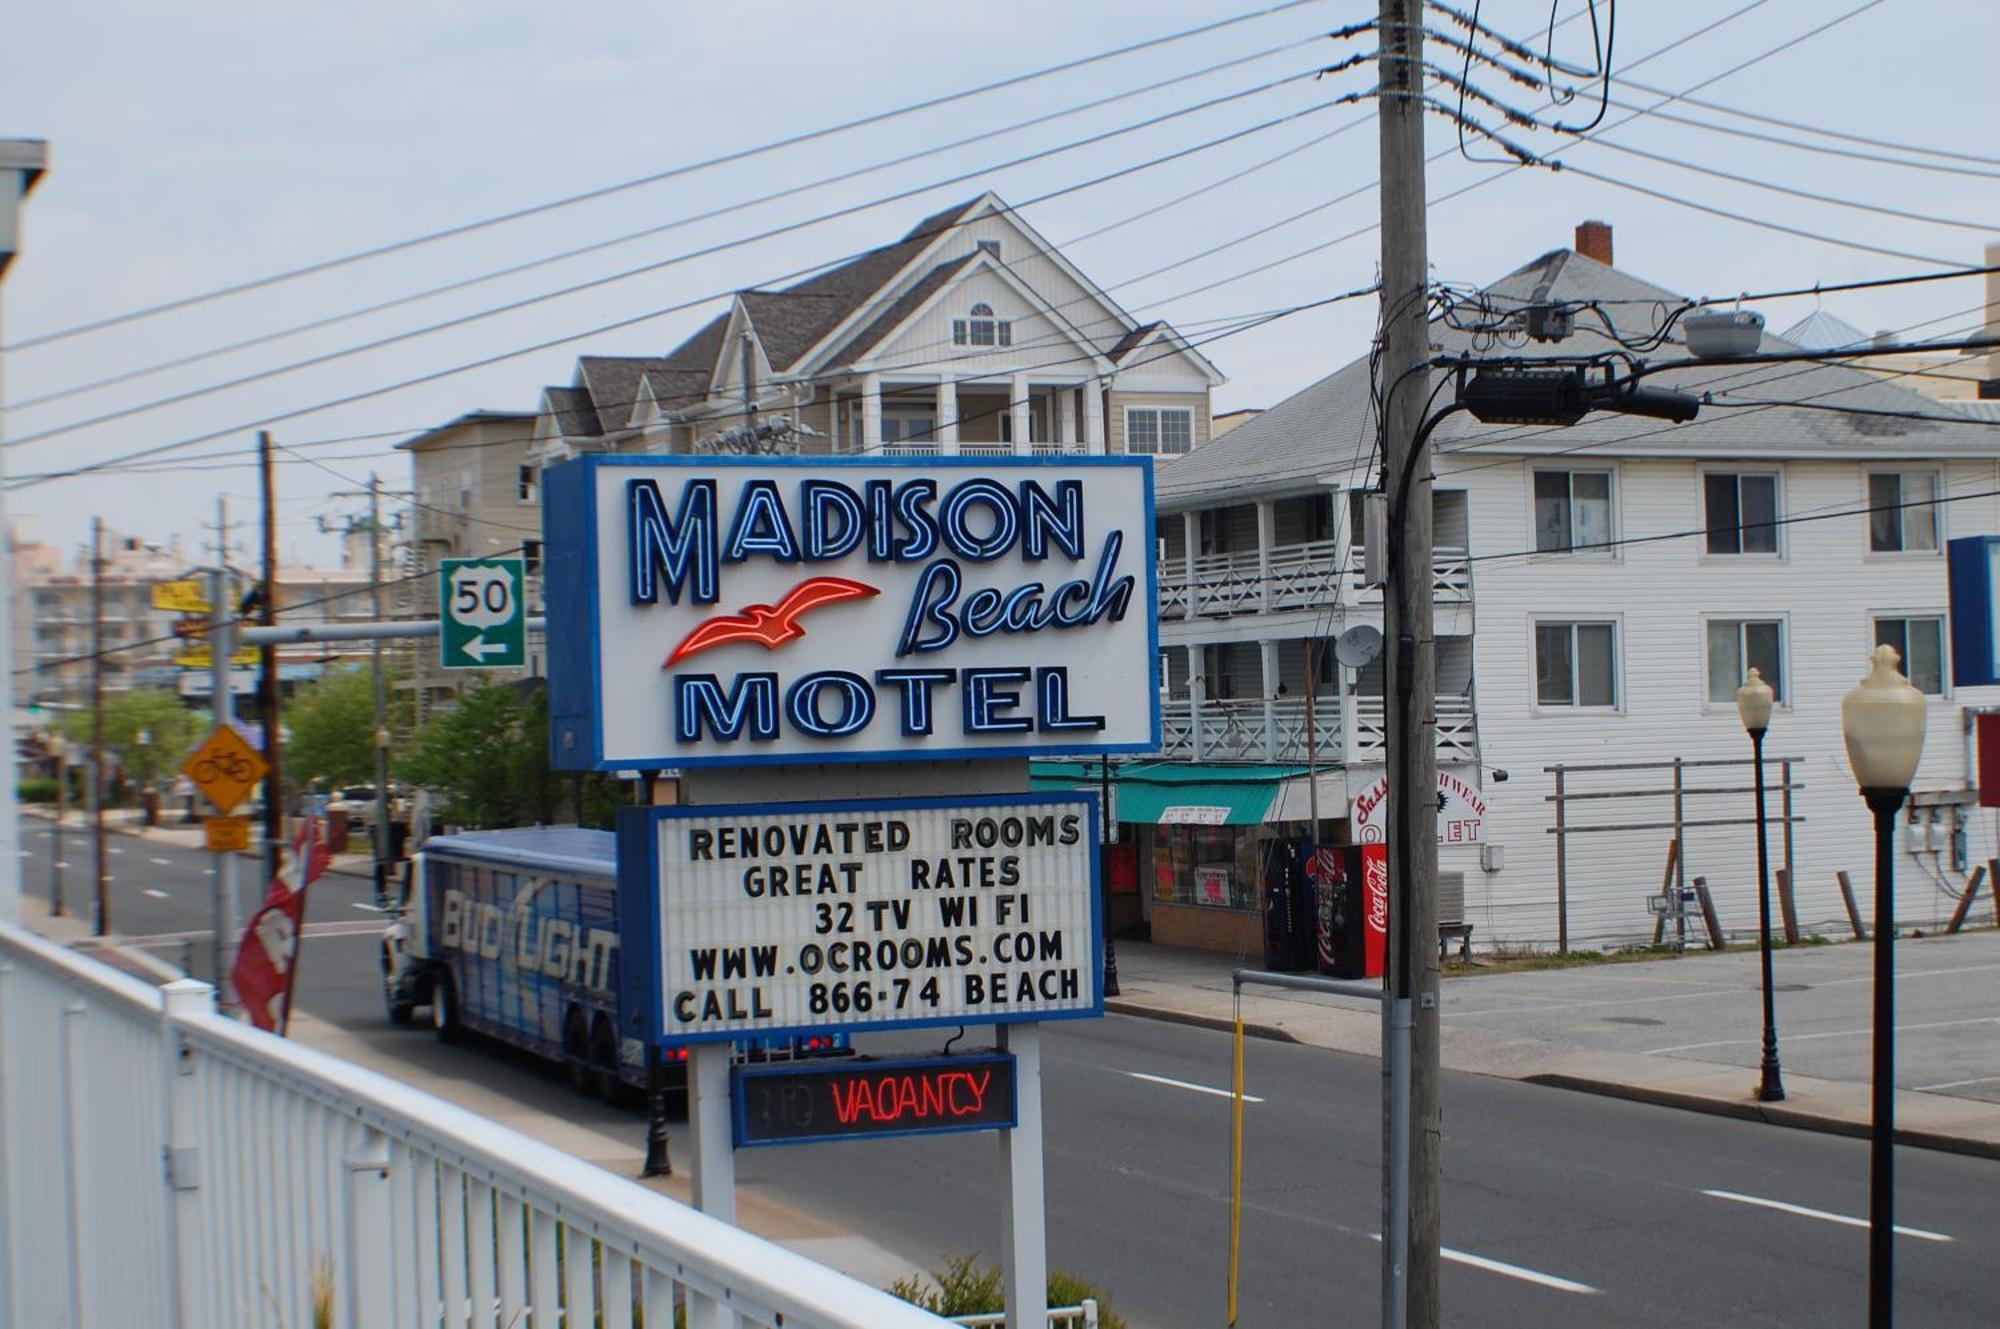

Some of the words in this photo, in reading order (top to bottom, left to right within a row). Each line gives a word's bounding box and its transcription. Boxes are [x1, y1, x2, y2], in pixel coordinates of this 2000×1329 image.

[626, 478, 1084, 606] MADISON
[457, 580, 507, 613] 50
[895, 530, 1135, 657] Beach
[674, 667, 1106, 743] MOTEL
[690, 821, 911, 860] RENOVATED
[951, 815, 1080, 849] ROOMS
[744, 862, 864, 897] GREAT
[911, 856, 1021, 889] RATES
[441, 888, 501, 960] BUD
[516, 876, 621, 991] LIGHT
[815, 902, 854, 934] 32
[866, 899, 911, 931] TV
[690, 930, 1063, 981] WWW.OCROOMS.COM
[674, 987, 773, 1023] CALL
[965, 969, 1079, 1005] BEACH
[832, 1071, 990, 1123] VACANCY
